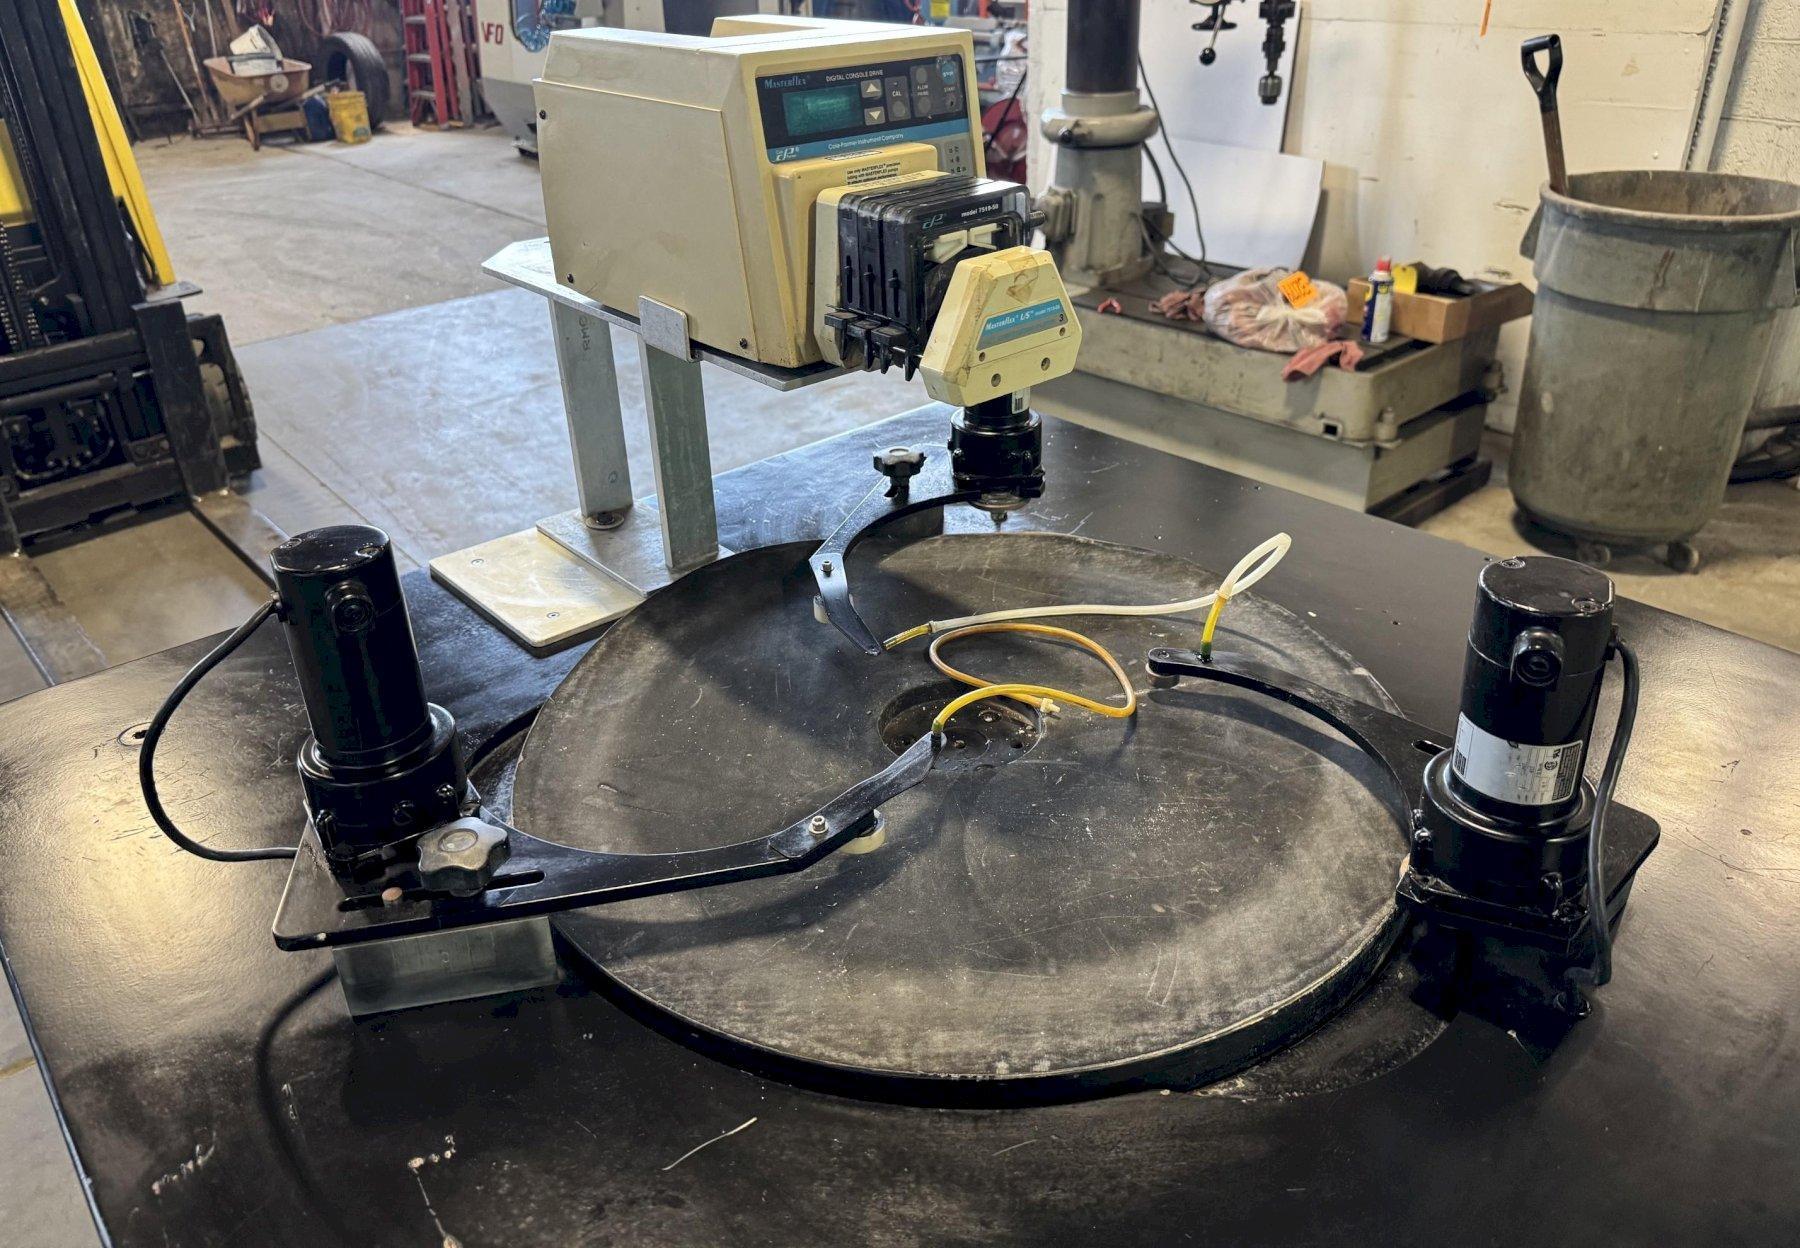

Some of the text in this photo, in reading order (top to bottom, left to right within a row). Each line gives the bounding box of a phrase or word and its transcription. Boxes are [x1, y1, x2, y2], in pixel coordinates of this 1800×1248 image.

[826, 69, 884, 83] DIGITAL CONSOLE DRIVE
[882, 133, 904, 143] Company
[961, 209, 978, 218] model
[1058, 313, 1064, 322] 3
